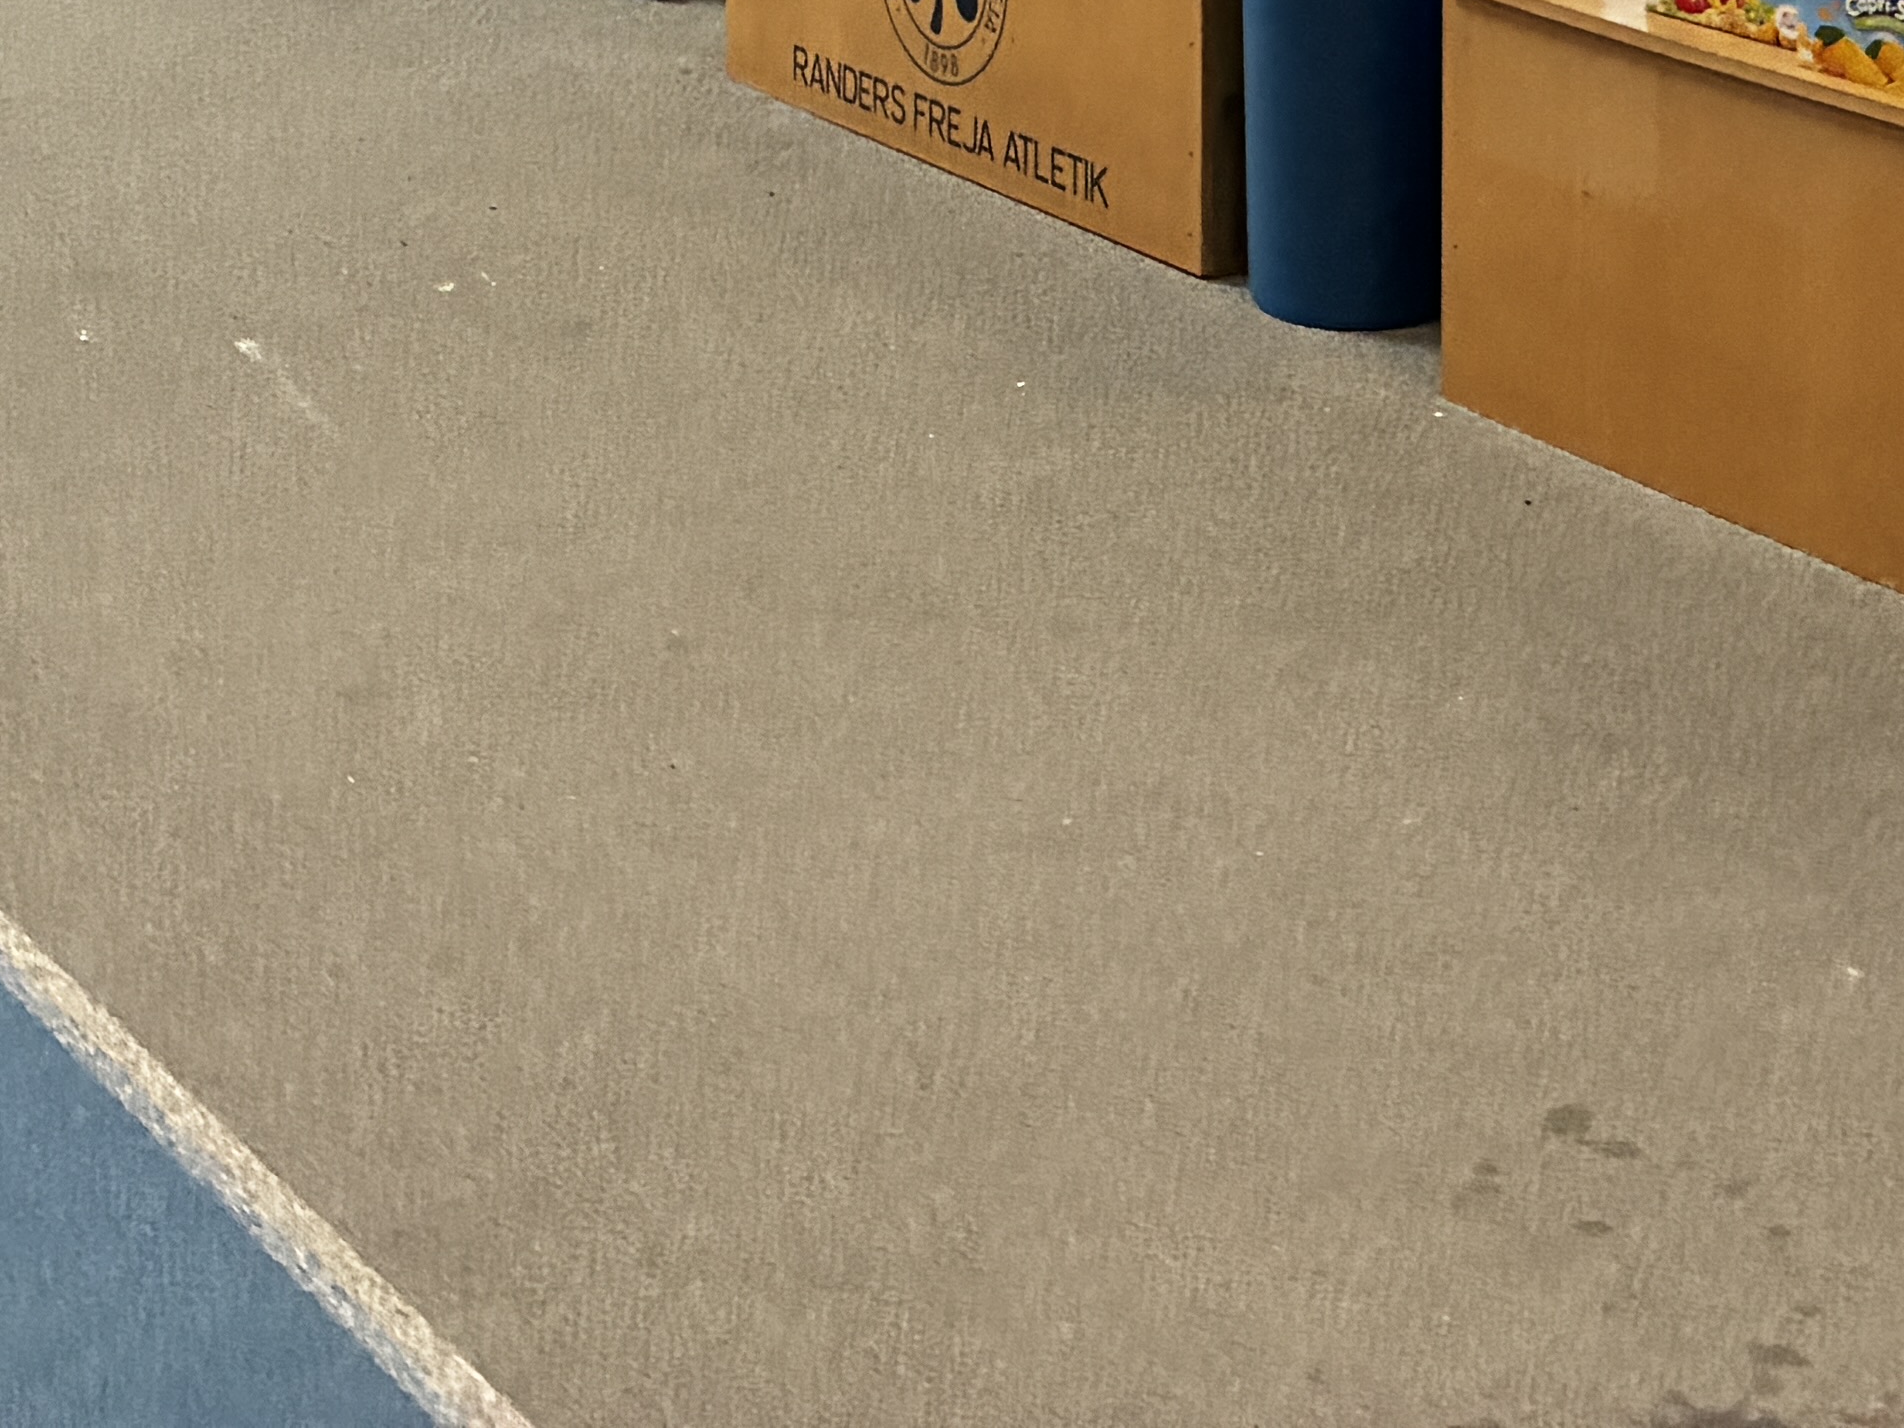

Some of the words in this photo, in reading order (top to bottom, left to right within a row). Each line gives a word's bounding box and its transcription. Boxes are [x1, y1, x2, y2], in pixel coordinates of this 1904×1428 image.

[793, 45, 906, 126] RANDERS
[911, 92, 995, 162] FREJA
[1002, 130, 1110, 209] ATLETIK
